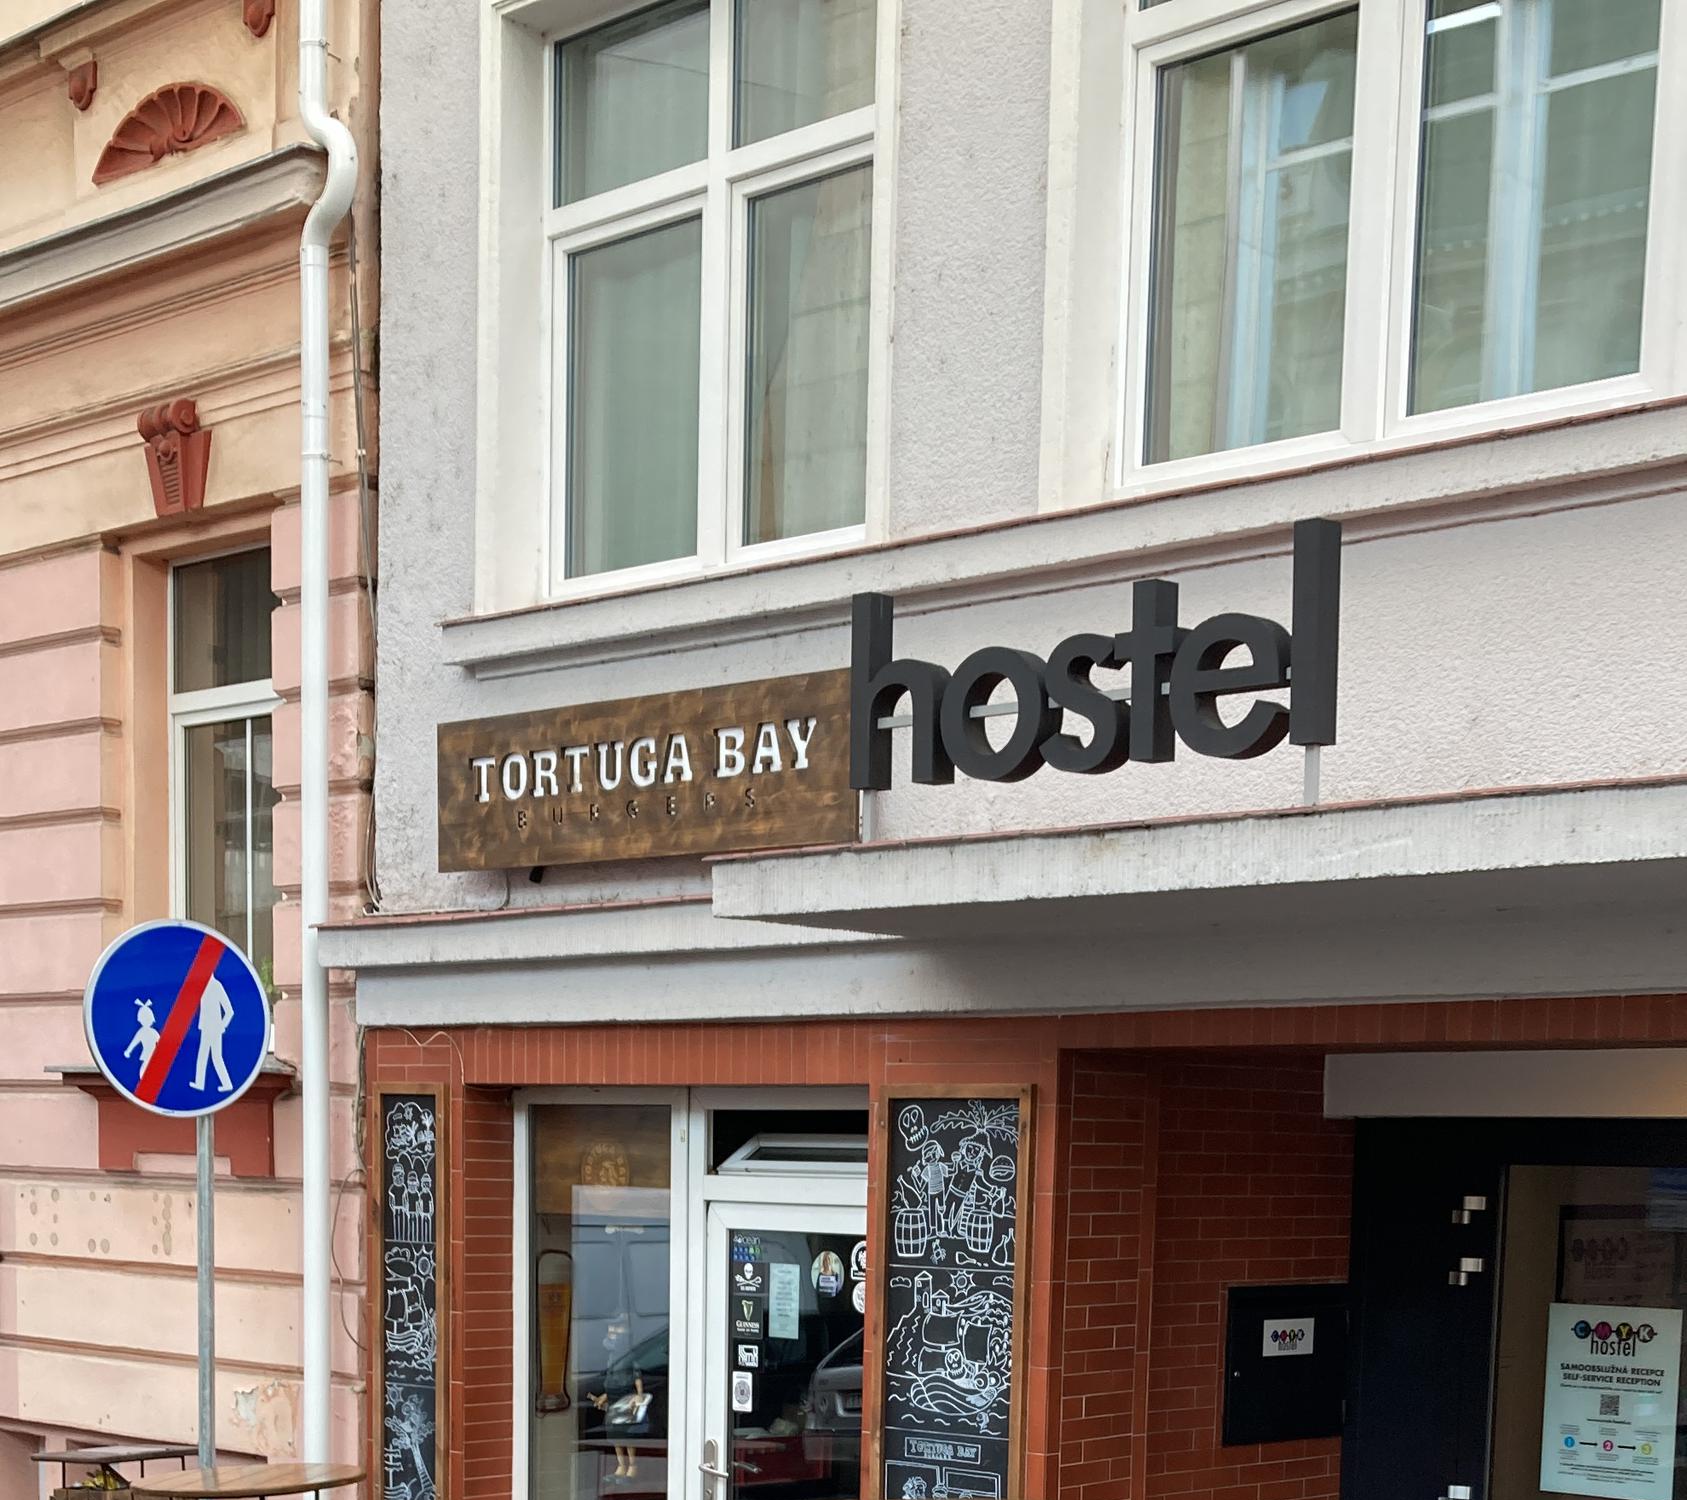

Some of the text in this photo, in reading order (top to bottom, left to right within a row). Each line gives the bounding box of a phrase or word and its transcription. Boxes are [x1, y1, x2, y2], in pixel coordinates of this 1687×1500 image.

[850, 518, 1341, 790] hostel
[469, 717, 817, 803] TORTUGA BAY
[517, 787, 756, 831] BURGERS
[1590, 1331, 1636, 1357] hostel
[1562, 1373, 1661, 1387] SELF-SERVICE RECEPTION
[1631, 1367, 1665, 1377] RECEPCE
